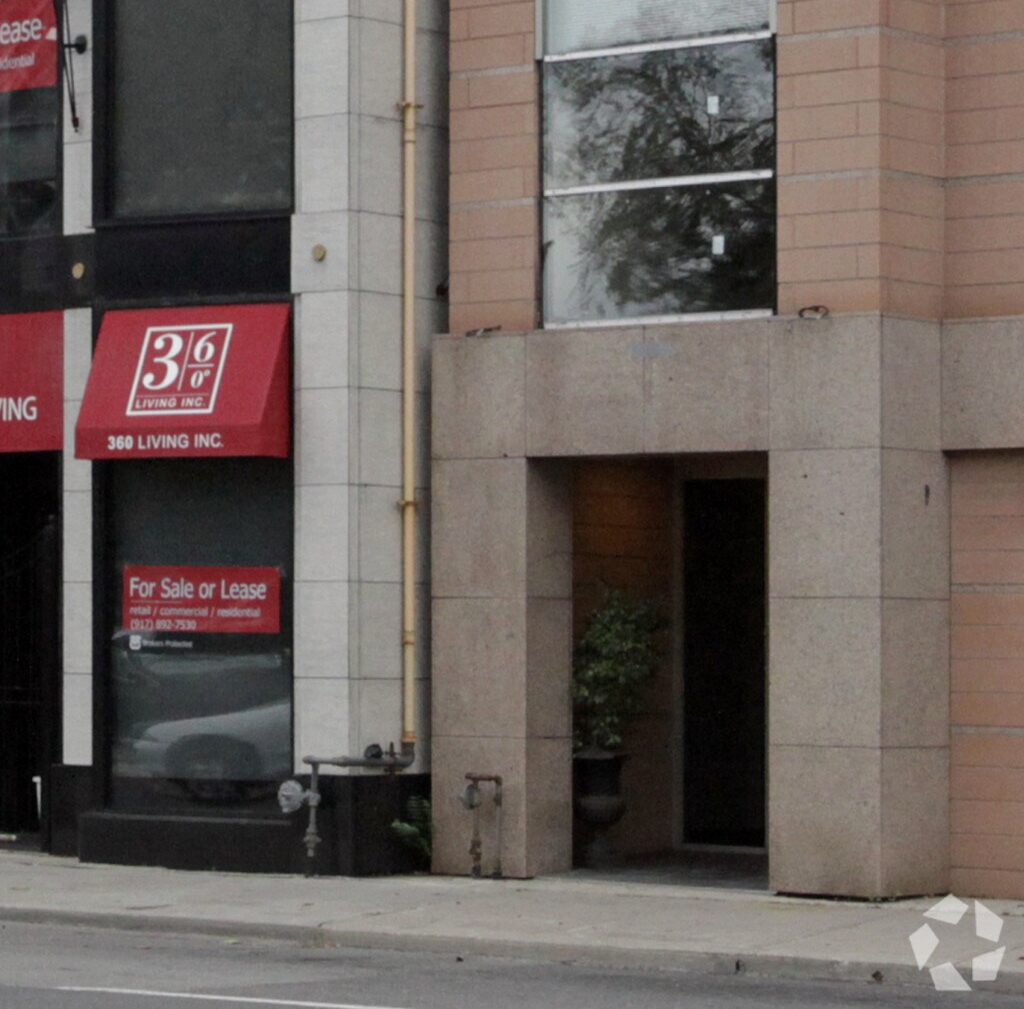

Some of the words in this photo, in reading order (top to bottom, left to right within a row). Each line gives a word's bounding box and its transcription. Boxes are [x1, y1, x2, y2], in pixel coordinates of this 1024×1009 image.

[134, 397, 177, 410] LIVING
[107, 434, 133, 451] 360
[137, 433, 189, 450] LIVING
[129, 577, 156, 598] For
[160, 577, 195, 600] Sale
[198, 582, 217, 600] or
[220, 578, 268, 601] Lease
[129, 605, 152, 616] retail
[159, 606, 209, 617] commercial
[216, 606, 262, 619] residential
[130, 619, 154, 631] (917)
[155, 619, 197, 630] 892-7530
